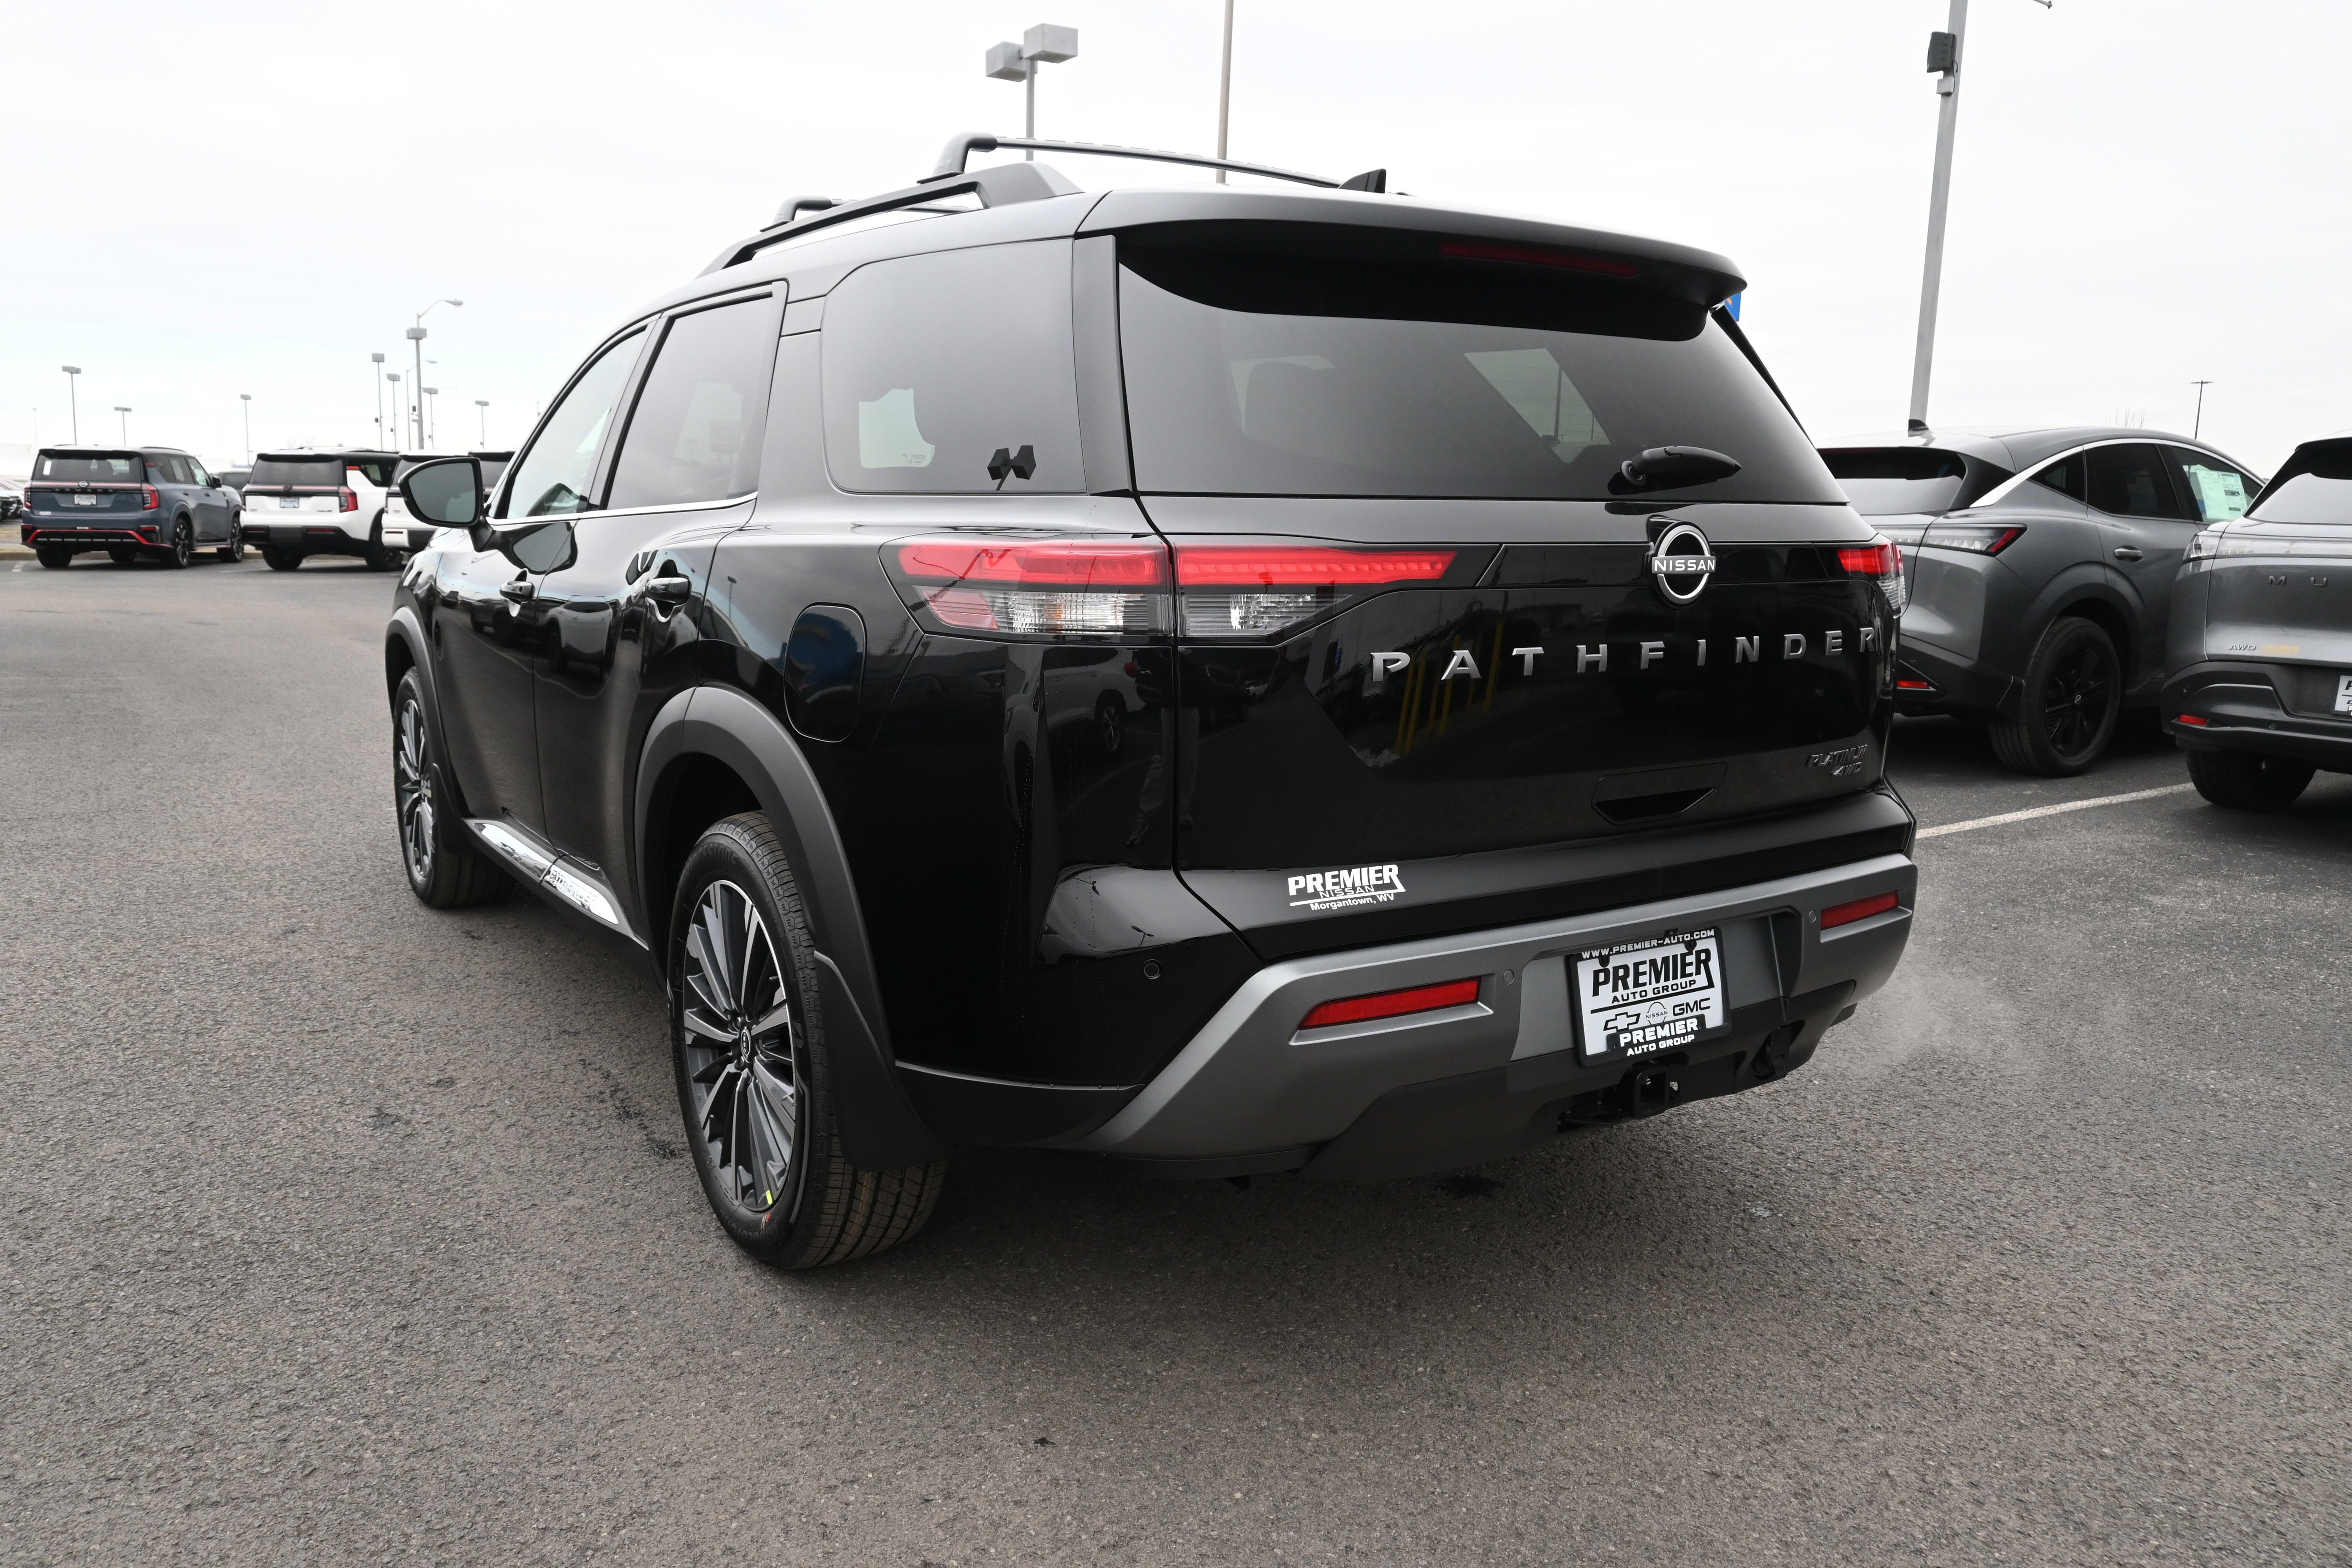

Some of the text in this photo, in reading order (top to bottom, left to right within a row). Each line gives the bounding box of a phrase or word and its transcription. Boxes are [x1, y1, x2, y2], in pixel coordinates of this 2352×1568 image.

[1654, 559, 1715, 572] NISSAN
[1369, 626, 1876, 683] PATHFINDER
[1288, 864, 1406, 896] PREMIER
[1319, 885, 1375, 898] NISSAN
[1309, 893, 1394, 911] Morgantown, WV
[1582, 928, 1715, 959] WWW.PREMIER-AUTO.COM
[1592, 947, 1715, 997] PREMIER
[1611, 979, 1696, 1004] AUTO GROUP
[1646, 1010, 1668, 1019] NISSAN
[1672, 997, 1711, 1017] GMC
[1619, 1018, 1699, 1047] PREMIER
[1626, 1034, 1695, 1056] AUTO GROUP
